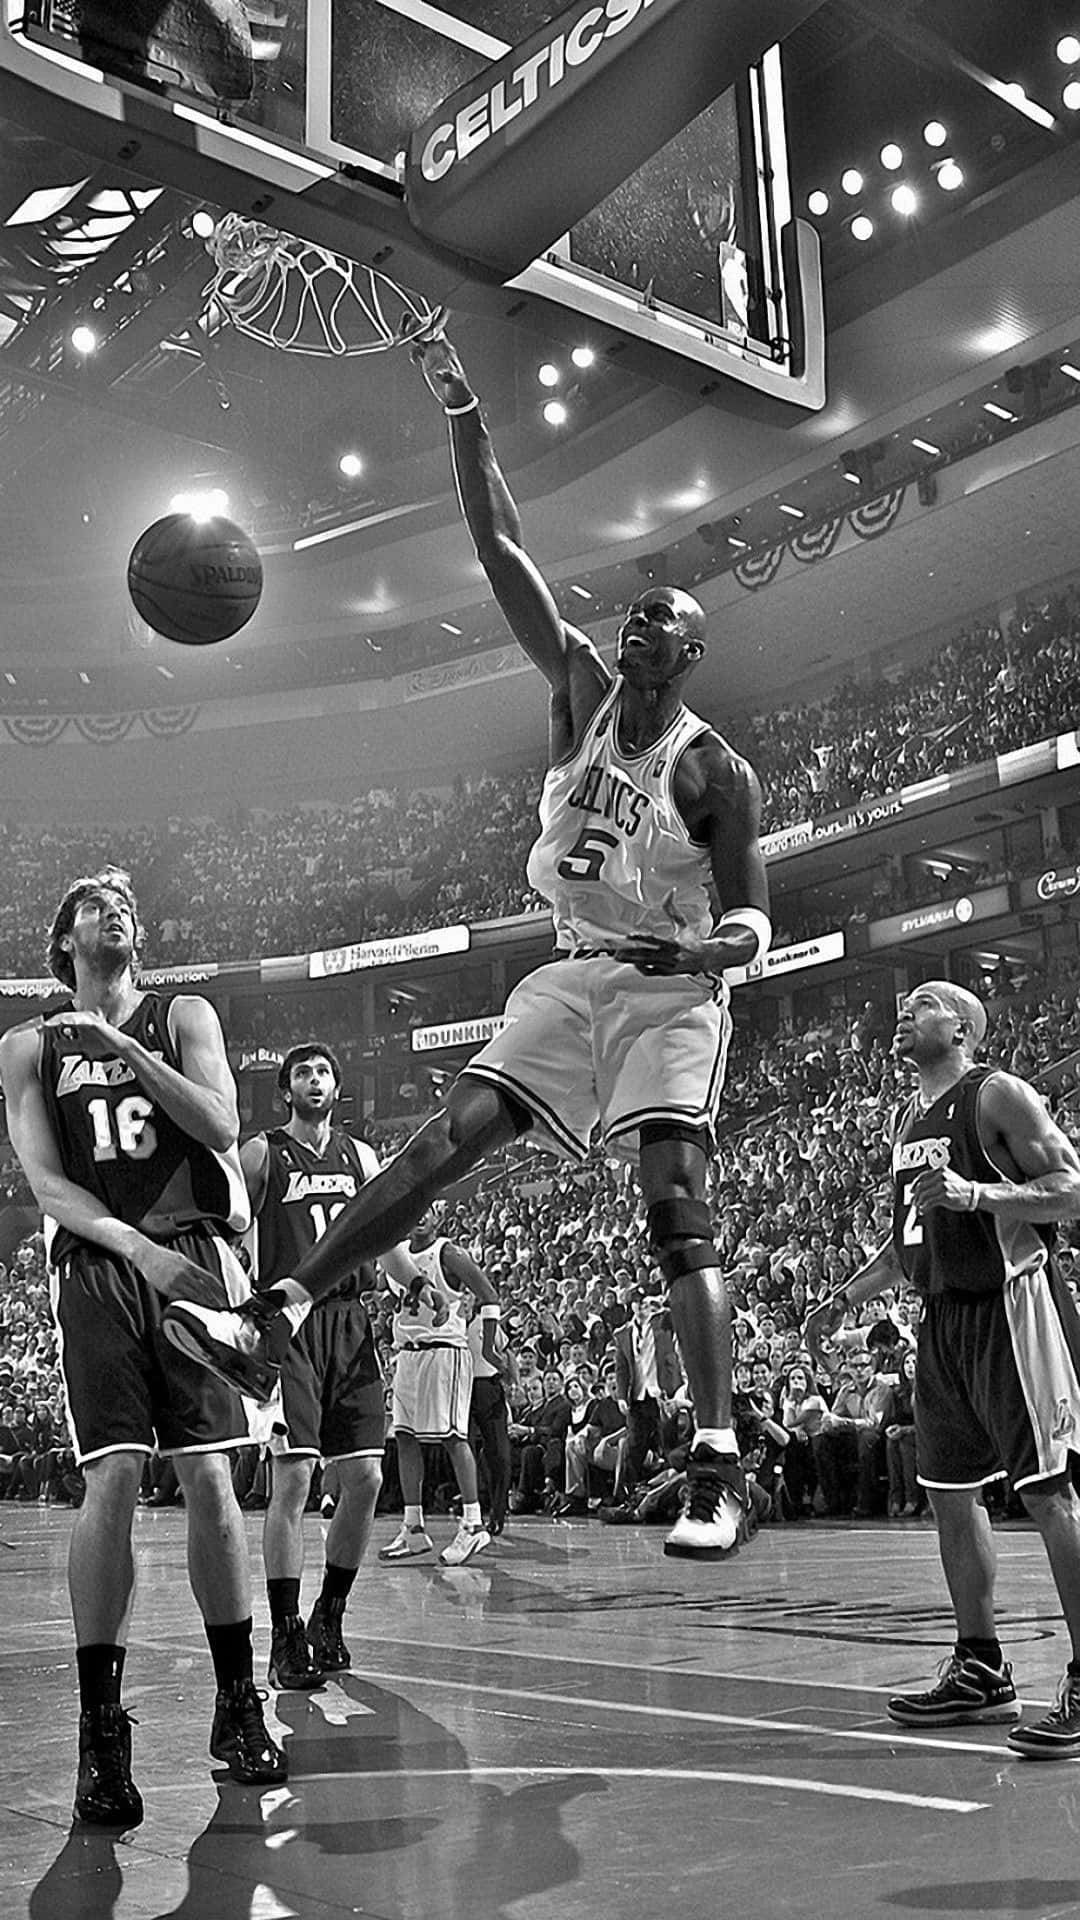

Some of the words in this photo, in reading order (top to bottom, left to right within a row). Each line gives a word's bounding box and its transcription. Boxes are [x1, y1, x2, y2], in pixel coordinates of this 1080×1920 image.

[557, 827, 620, 881] 5
[901, 908, 954, 932] SYLVANIA
[88, 1096, 158, 1162] 16
